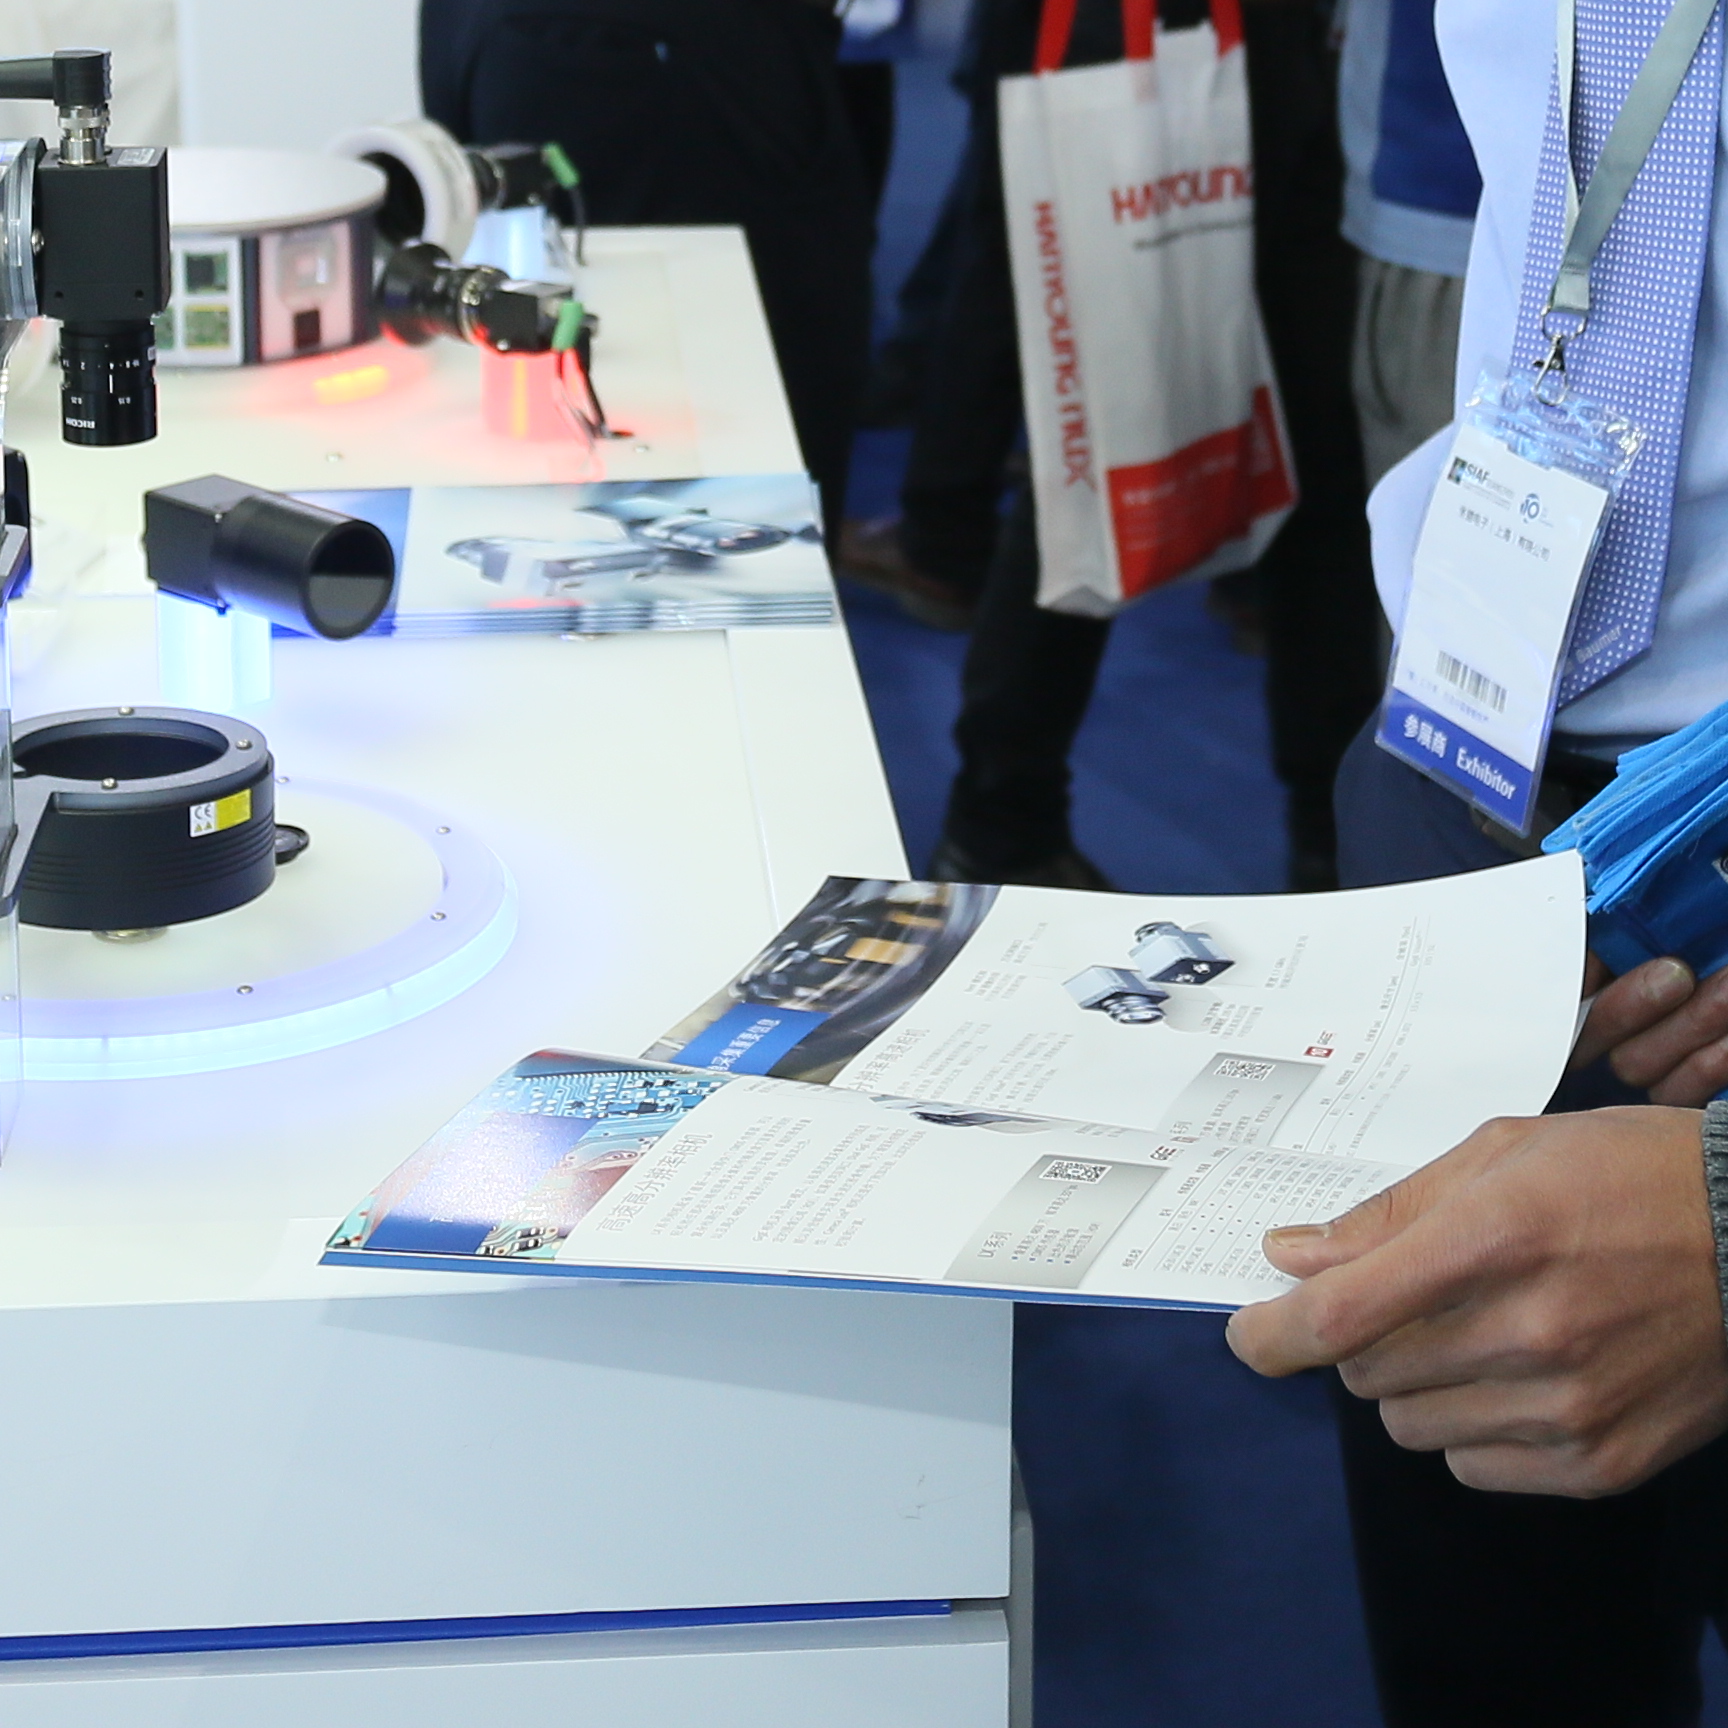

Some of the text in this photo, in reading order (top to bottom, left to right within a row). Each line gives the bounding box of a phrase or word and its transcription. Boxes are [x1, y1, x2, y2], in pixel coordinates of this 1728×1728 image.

[1403, 714, 1516, 800] 参展商 Exhibitor
[595, 1131, 713, 1233] 高速高分辨率相机
